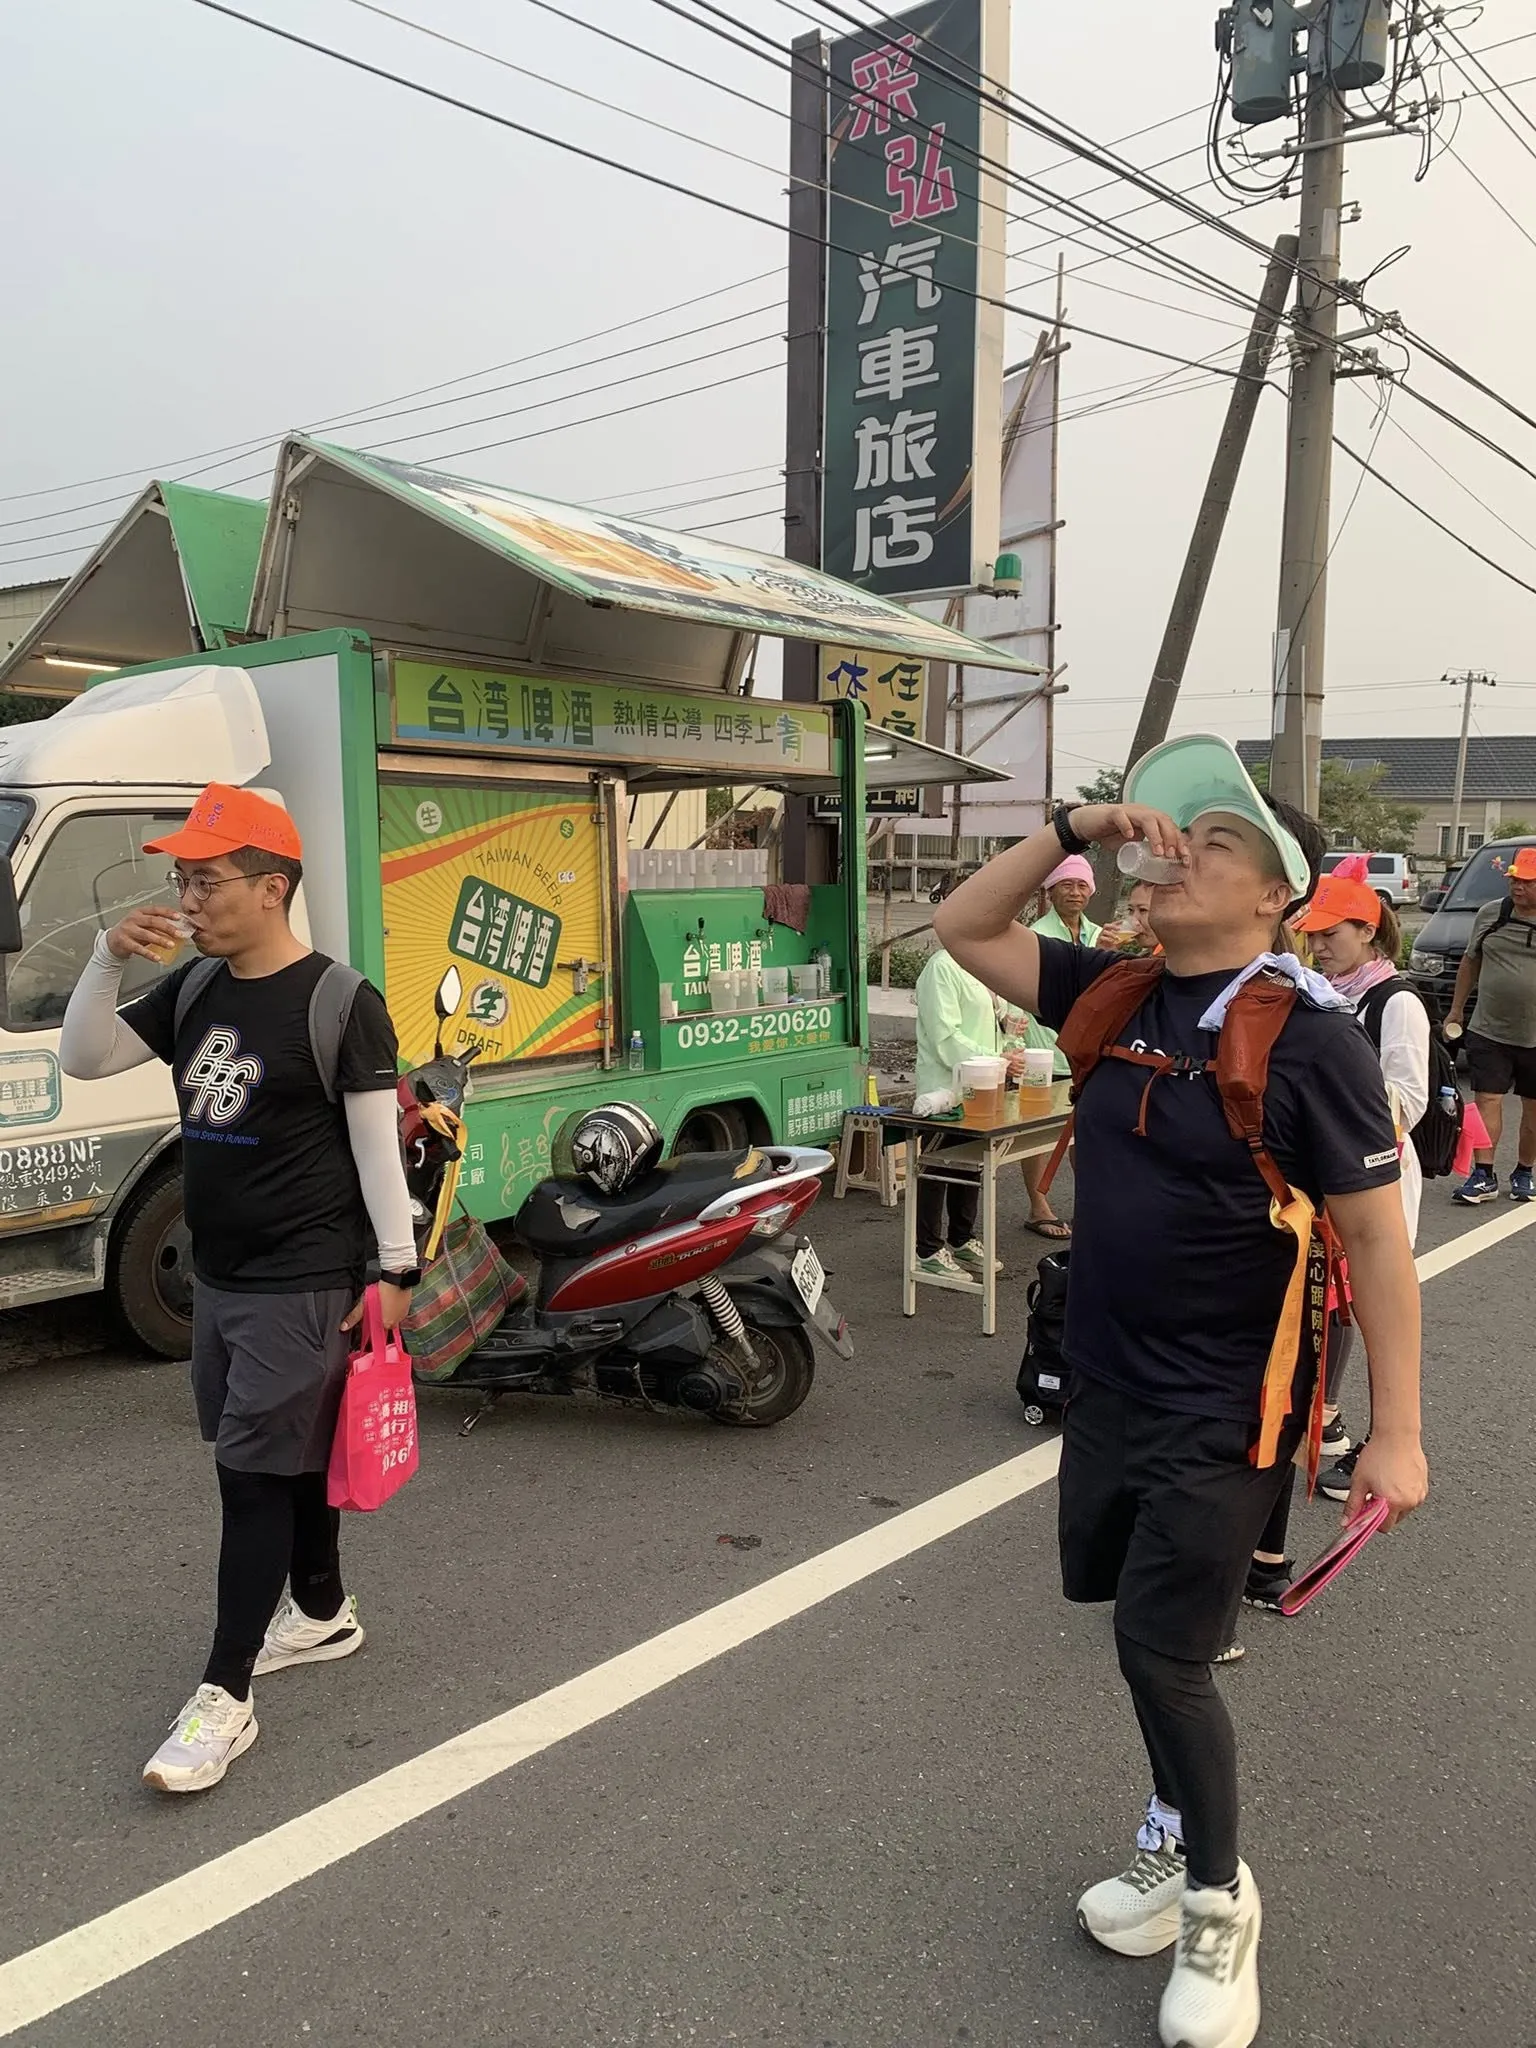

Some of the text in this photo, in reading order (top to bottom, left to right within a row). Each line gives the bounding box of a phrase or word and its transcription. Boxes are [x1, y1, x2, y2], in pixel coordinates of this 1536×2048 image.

[613, 700, 702, 741] 熱情台灣
[714, 711, 807, 765] 四季上青
[420, 805, 439, 829] 生
[476, 848, 563, 908] TAIWAN BEER
[457, 1029, 503, 1056] DRAFT
[678, 1006, 832, 1049] 0932-520620
[224, 1133, 260, 1146] RUNNING
